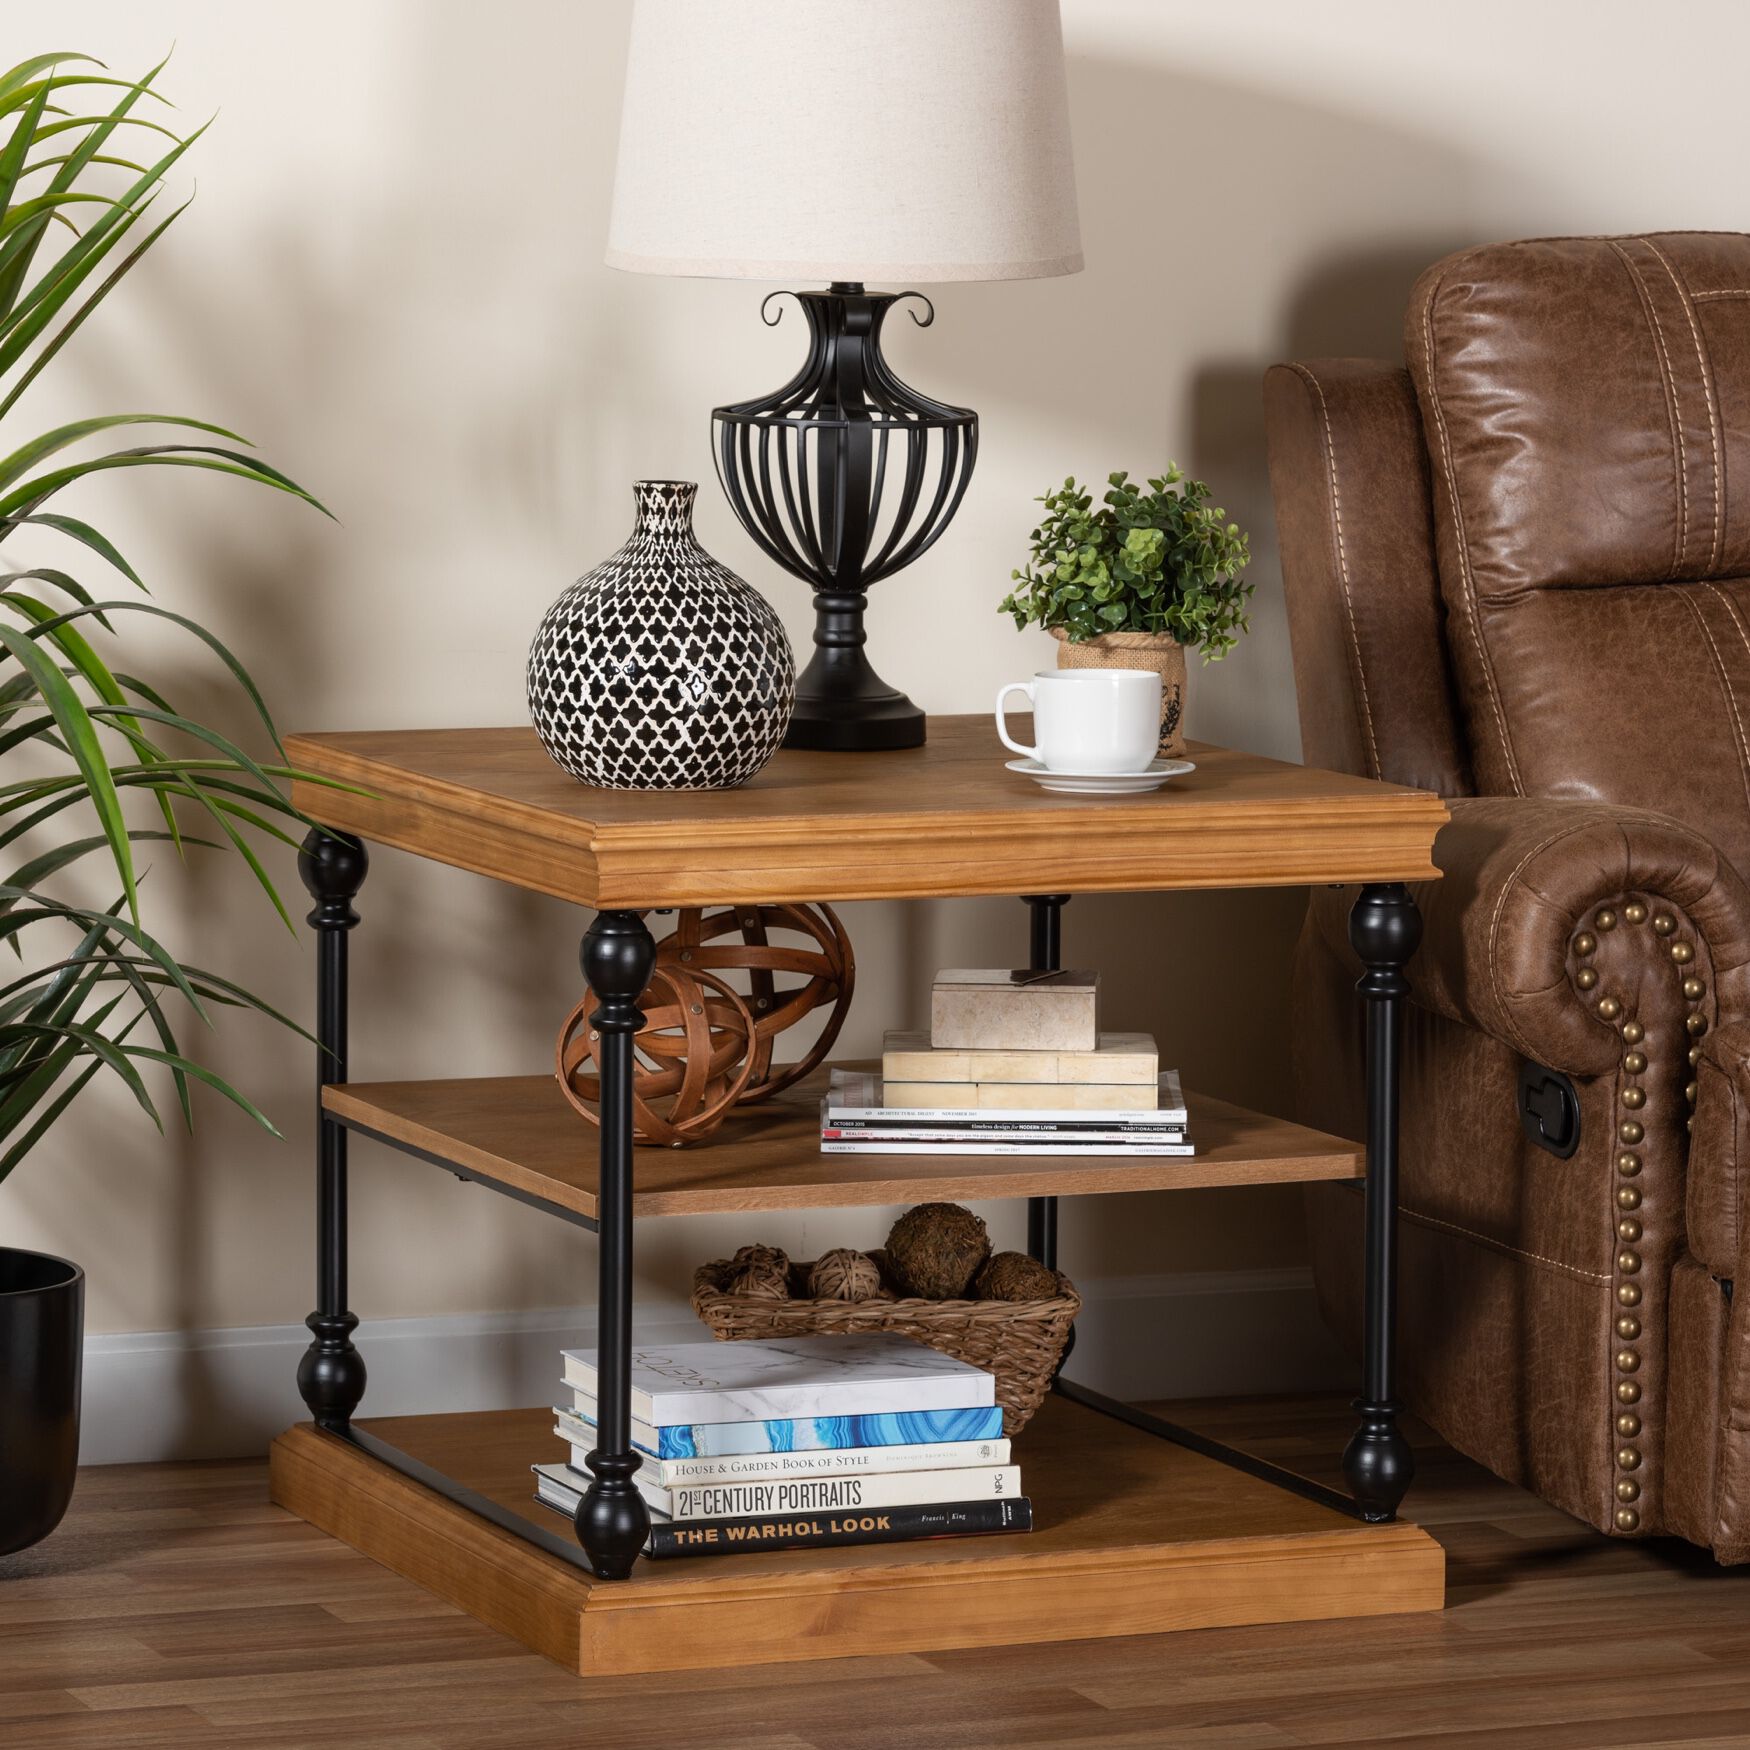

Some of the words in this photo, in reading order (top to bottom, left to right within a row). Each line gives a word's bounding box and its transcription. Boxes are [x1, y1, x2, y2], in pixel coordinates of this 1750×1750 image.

[993, 1123, 1011, 1131] design
[675, 1463, 715, 1476] HOUSE
[718, 1464, 727, 1474] &
[731, 1461, 779, 1473] GARDEN
[782, 1458, 814, 1470] BOOK
[817, 1458, 833, 1467] OF
[836, 1455, 870, 1466] STYLE
[994, 1473, 1003, 1494] NPG
[703, 1486, 774, 1515] CENTURY
[778, 1480, 862, 1510] PORTRAITS
[921, 1514, 945, 1522] Francis
[951, 1512, 966, 1521] King
[673, 1528, 719, 1545] THE
[726, 1521, 823, 1542] WARHOL
[831, 1516, 891, 1533] LOOK
